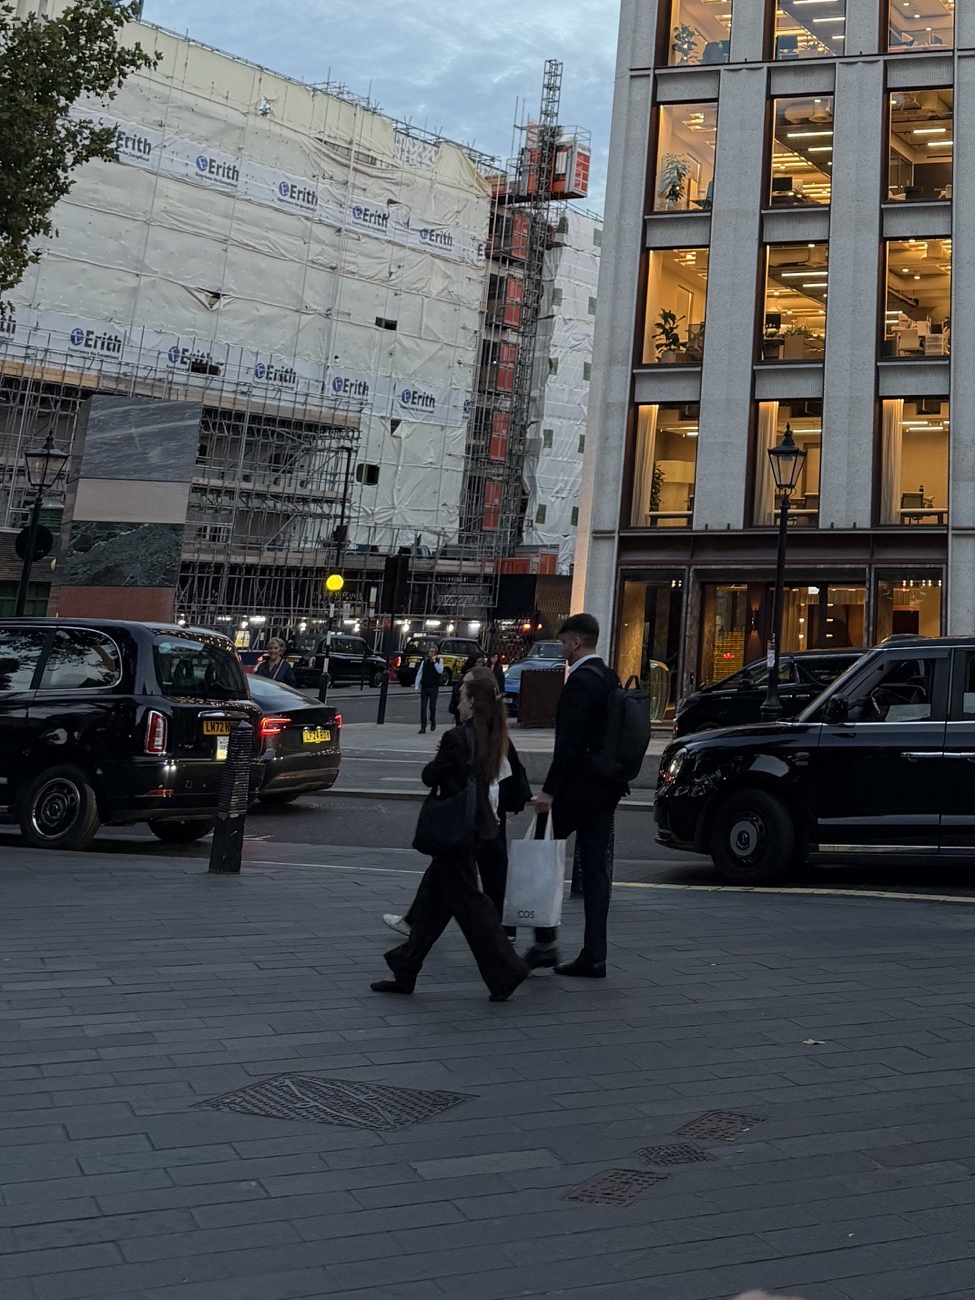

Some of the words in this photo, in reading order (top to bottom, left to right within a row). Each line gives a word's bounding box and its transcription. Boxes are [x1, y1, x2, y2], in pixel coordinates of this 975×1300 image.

[116, 130, 151, 156] Erith
[208, 158, 239, 182] Erith
[289, 183, 318, 207] Erith
[362, 208, 388, 228] Erith
[428, 229, 453, 245] Erith
[84, 329, 122, 353] Erith
[266, 364, 297, 384] Erith
[342, 377, 369, 397] Erith
[411, 391, 436, 409] Erith
[518, 910, 535, 919] COS
